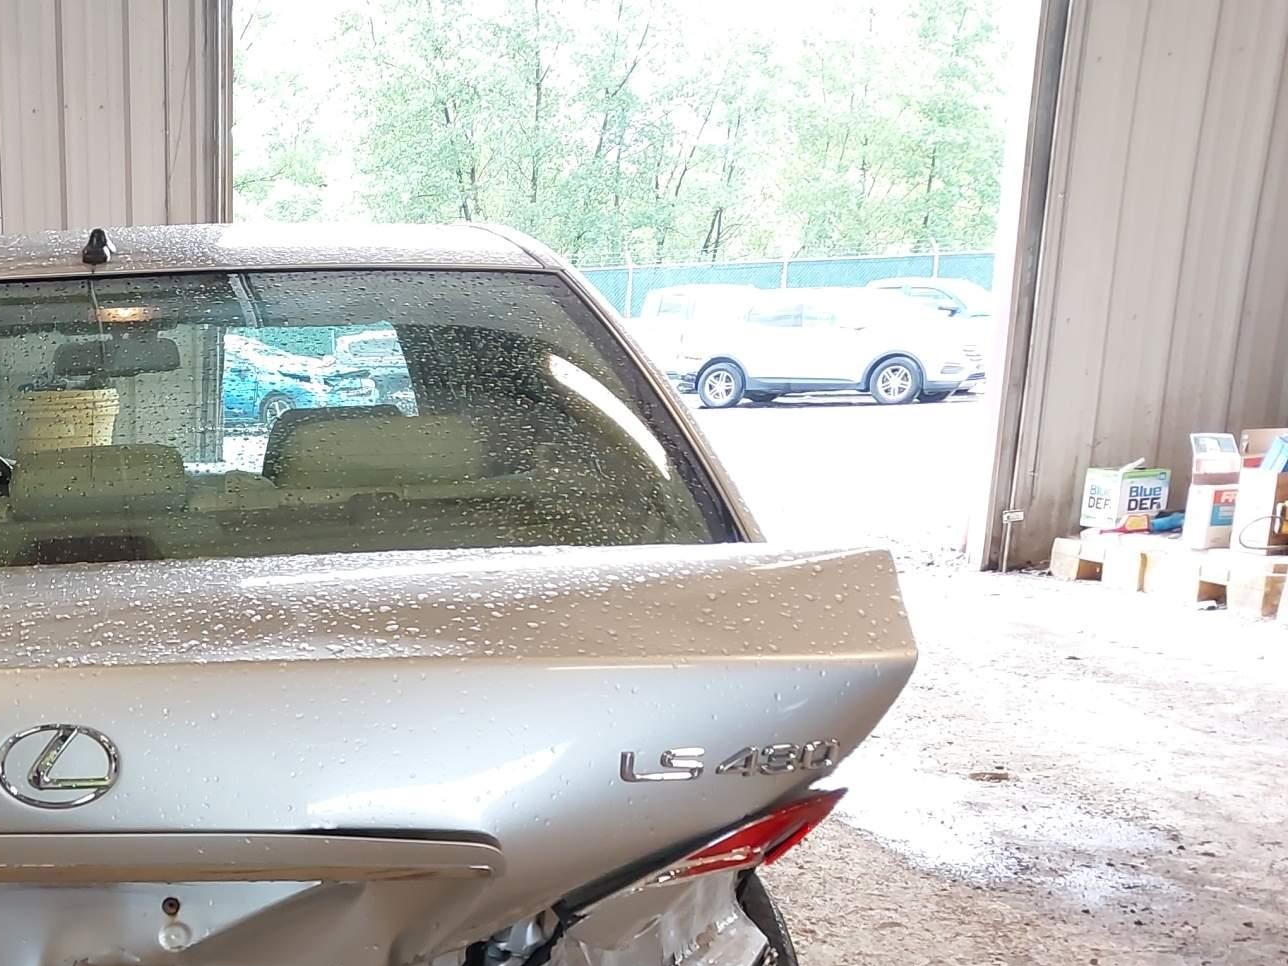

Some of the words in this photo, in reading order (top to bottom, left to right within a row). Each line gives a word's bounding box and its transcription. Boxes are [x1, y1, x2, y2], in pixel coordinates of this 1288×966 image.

[1129, 485, 1162, 498] Blue
[1127, 497, 1161, 511] DEF
[620, 747, 705, 782] LS
